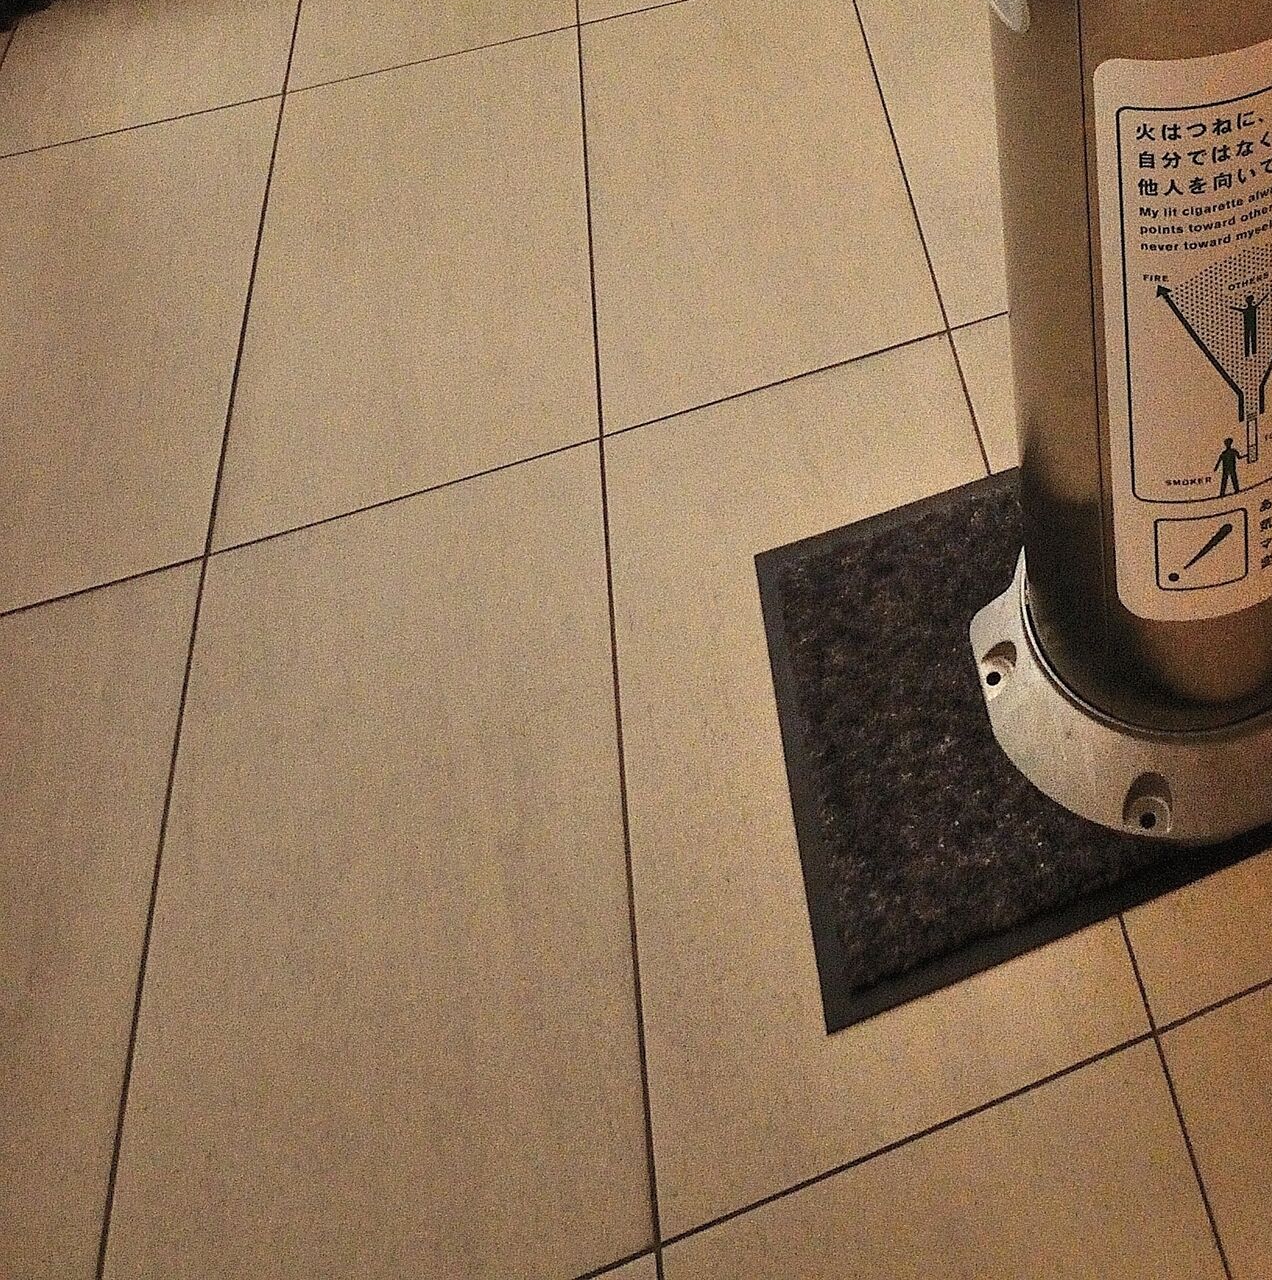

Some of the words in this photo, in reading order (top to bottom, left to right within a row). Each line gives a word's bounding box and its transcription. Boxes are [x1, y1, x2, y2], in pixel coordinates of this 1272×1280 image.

[1135, 110, 1264, 141] 火はつねに、
[1139, 207, 1159, 219] My
[1163, 207, 1178, 218] lit
[1182, 198, 1244, 217] cigarette
[1140, 223, 1184, 236] points
[1188, 216, 1236, 233] toward
[1140, 241, 1179, 252] never
[1184, 233, 1231, 250] toward
[1142, 274, 1169, 283] FIRE
